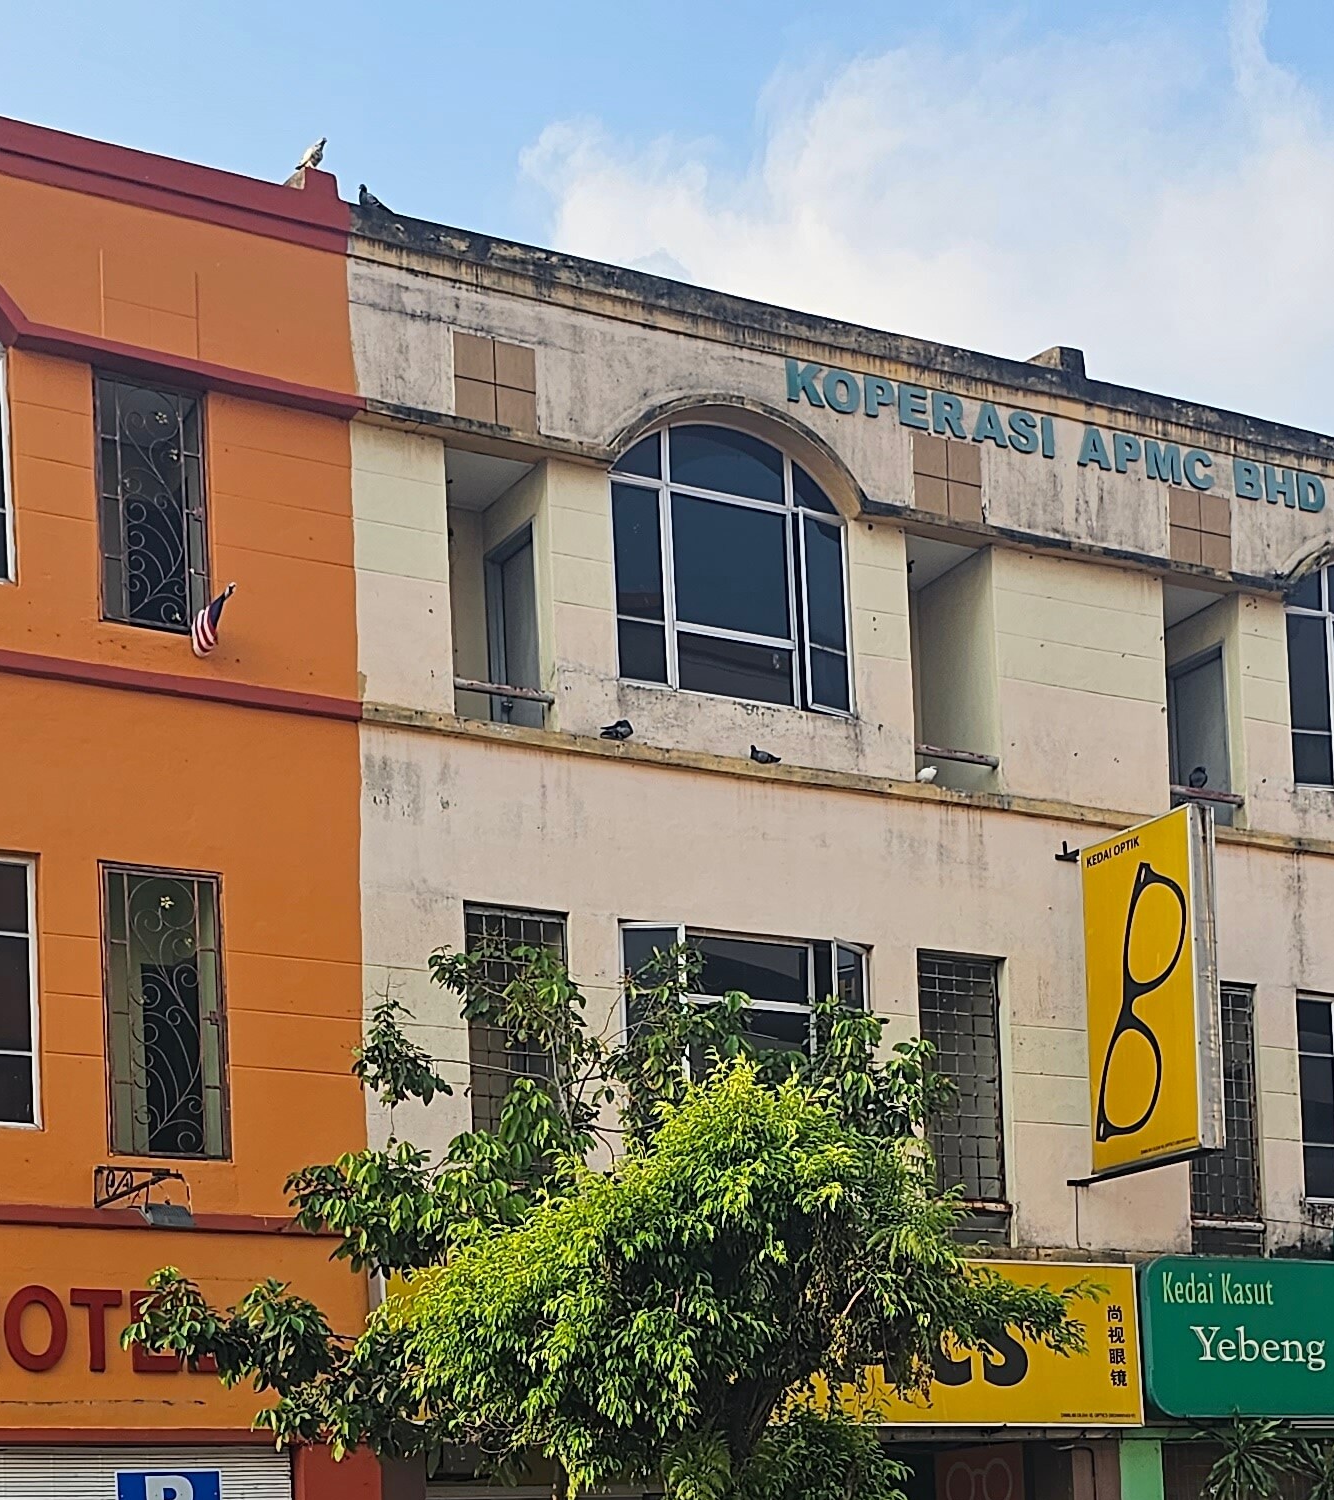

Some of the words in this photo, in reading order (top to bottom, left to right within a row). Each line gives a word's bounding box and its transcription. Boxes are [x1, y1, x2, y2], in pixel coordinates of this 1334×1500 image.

[784, 357, 1056, 460] KOPERASI
[1077, 427, 1215, 491] APMC
[1231, 457, 1327, 514] BHD
[1085, 848, 1112, 869] KEDAI
[1113, 835, 1141, 857] OPTIK
[1162, 1271, 1214, 1304] Kedai
[1220, 1272, 1274, 1306] Kasut
[1107, 1304, 1128, 1387] 尚视眼镜
[1189, 1325, 1326, 1371] Yebeng
